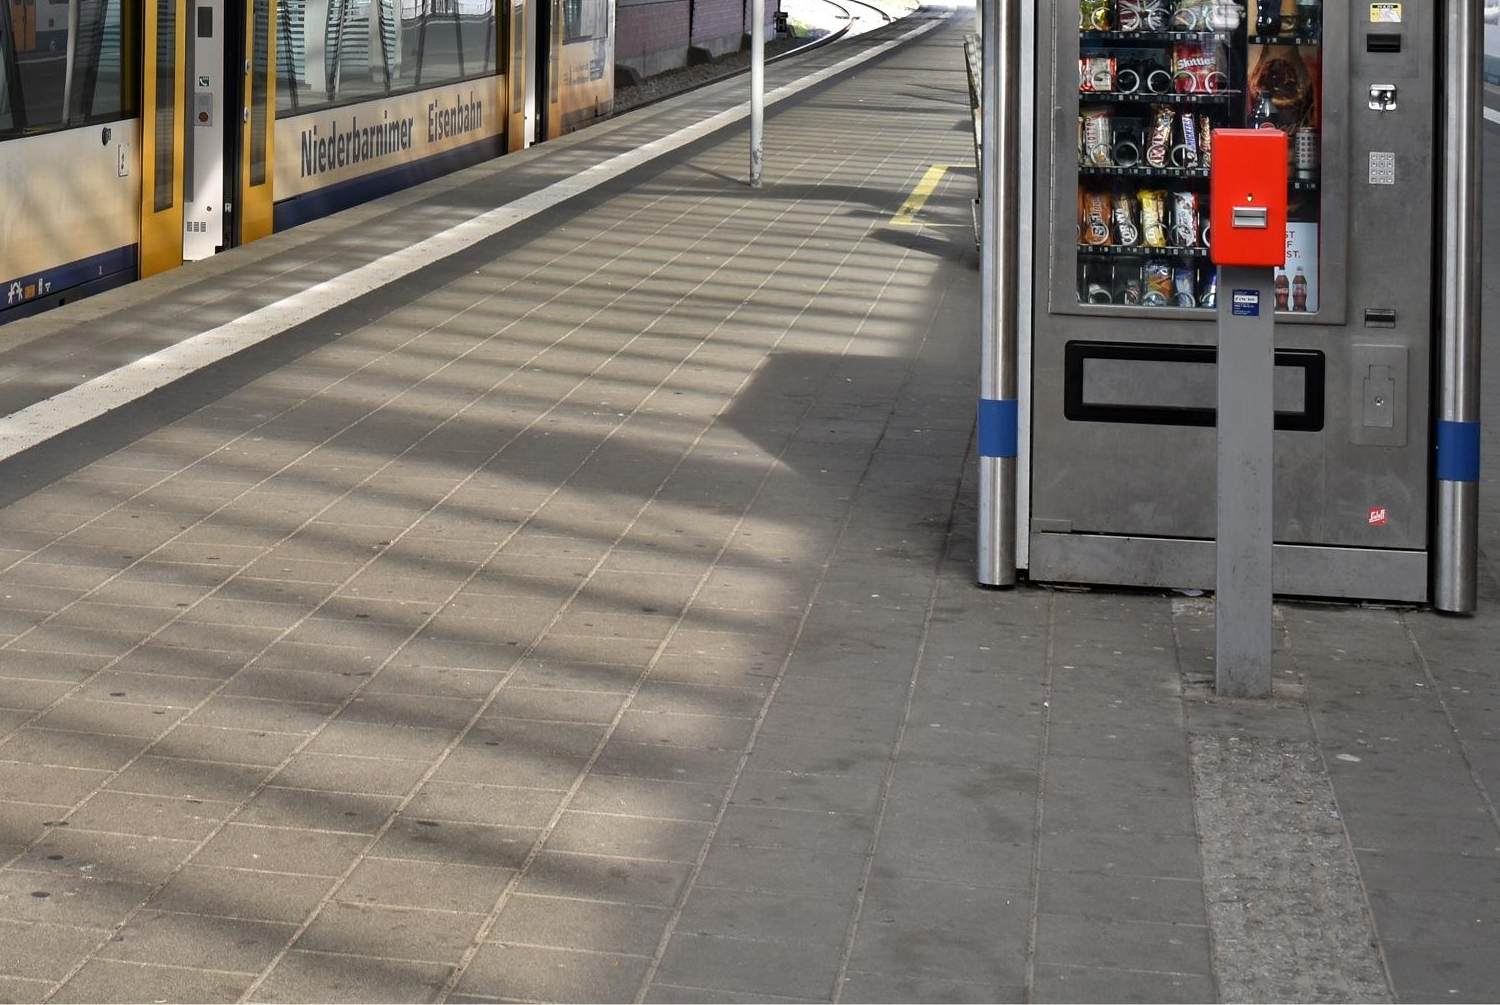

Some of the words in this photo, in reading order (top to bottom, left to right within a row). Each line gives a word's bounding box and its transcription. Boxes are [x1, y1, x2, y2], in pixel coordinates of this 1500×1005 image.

[1177, 56, 1216, 69] Skittles
[301, 109, 414, 178] Niederbarnimer
[428, 91, 482, 143] Eisenbahn
